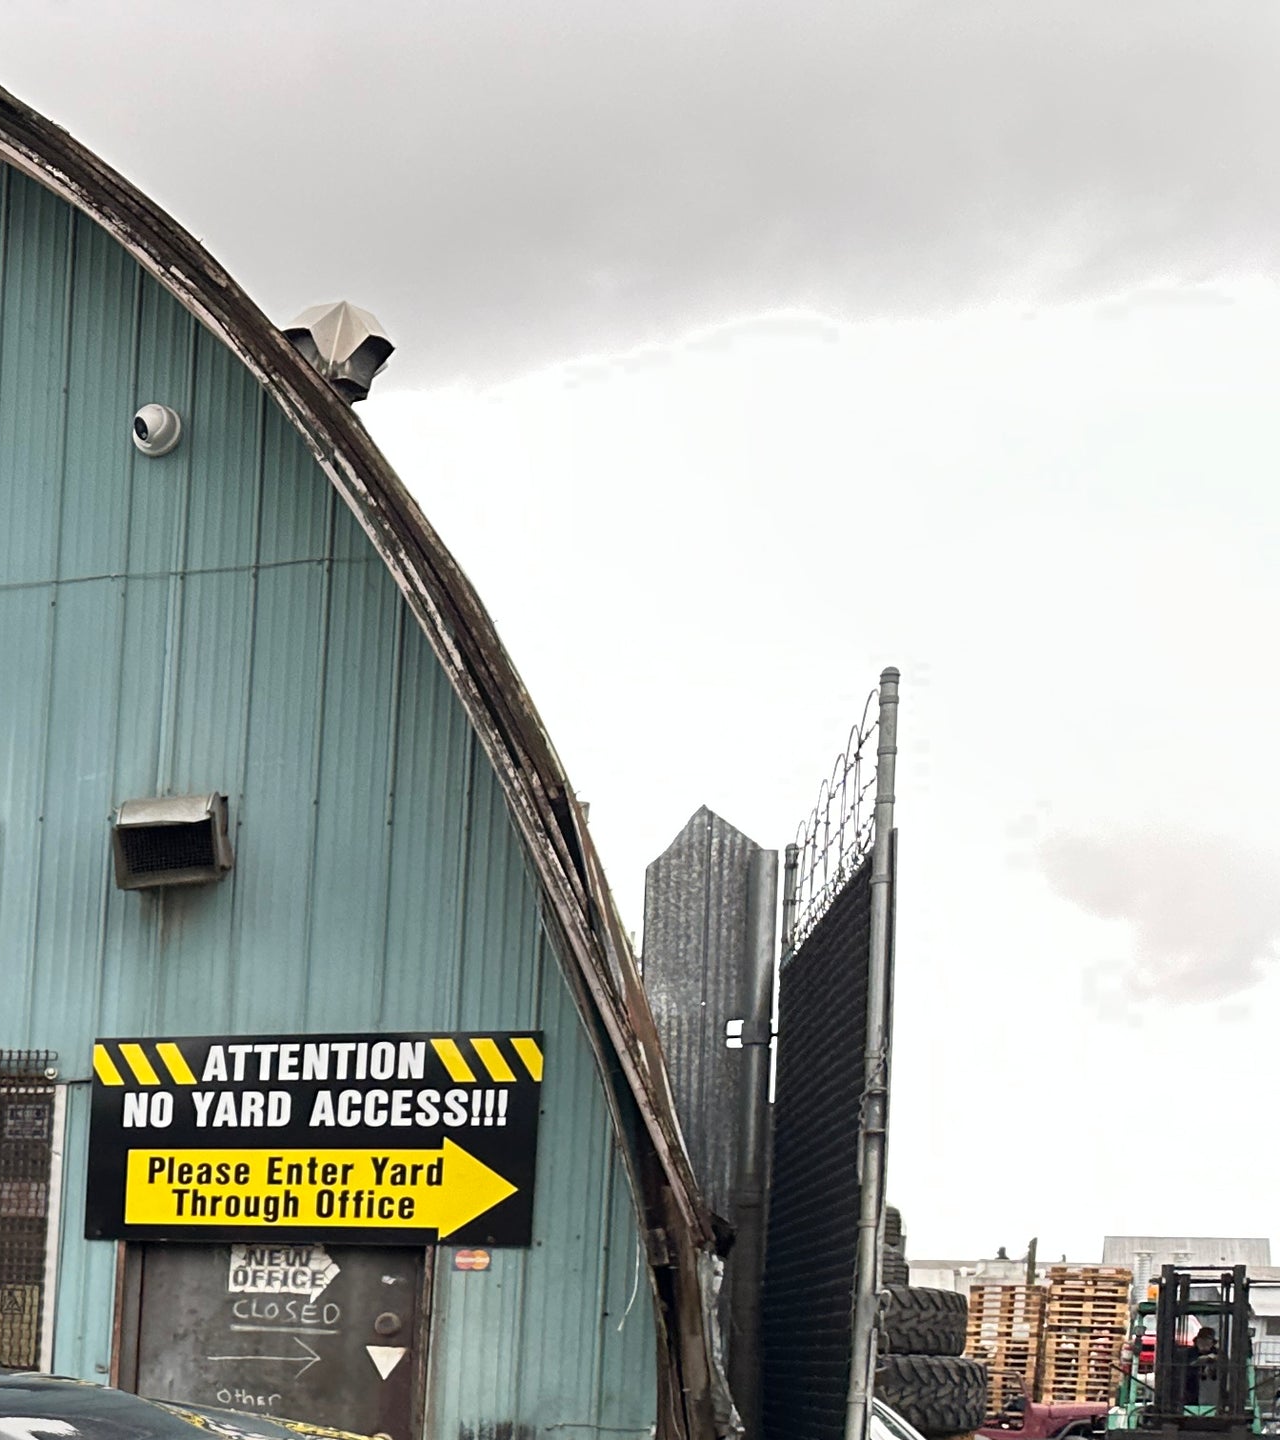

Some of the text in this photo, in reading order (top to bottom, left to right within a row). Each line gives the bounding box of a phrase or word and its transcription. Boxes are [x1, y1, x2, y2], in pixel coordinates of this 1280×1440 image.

[202, 1041, 426, 1082] ATTENTION
[123, 1089, 509, 1128] NO YARD ACCESS!!!
[148, 1157, 443, 1187] Please Enter Yard
[172, 1189, 416, 1223] Through Office
[244, 1250, 312, 1267] NEW
[233, 1266, 325, 1289] OFFICE
[233, 1300, 340, 1324] CLOSED
